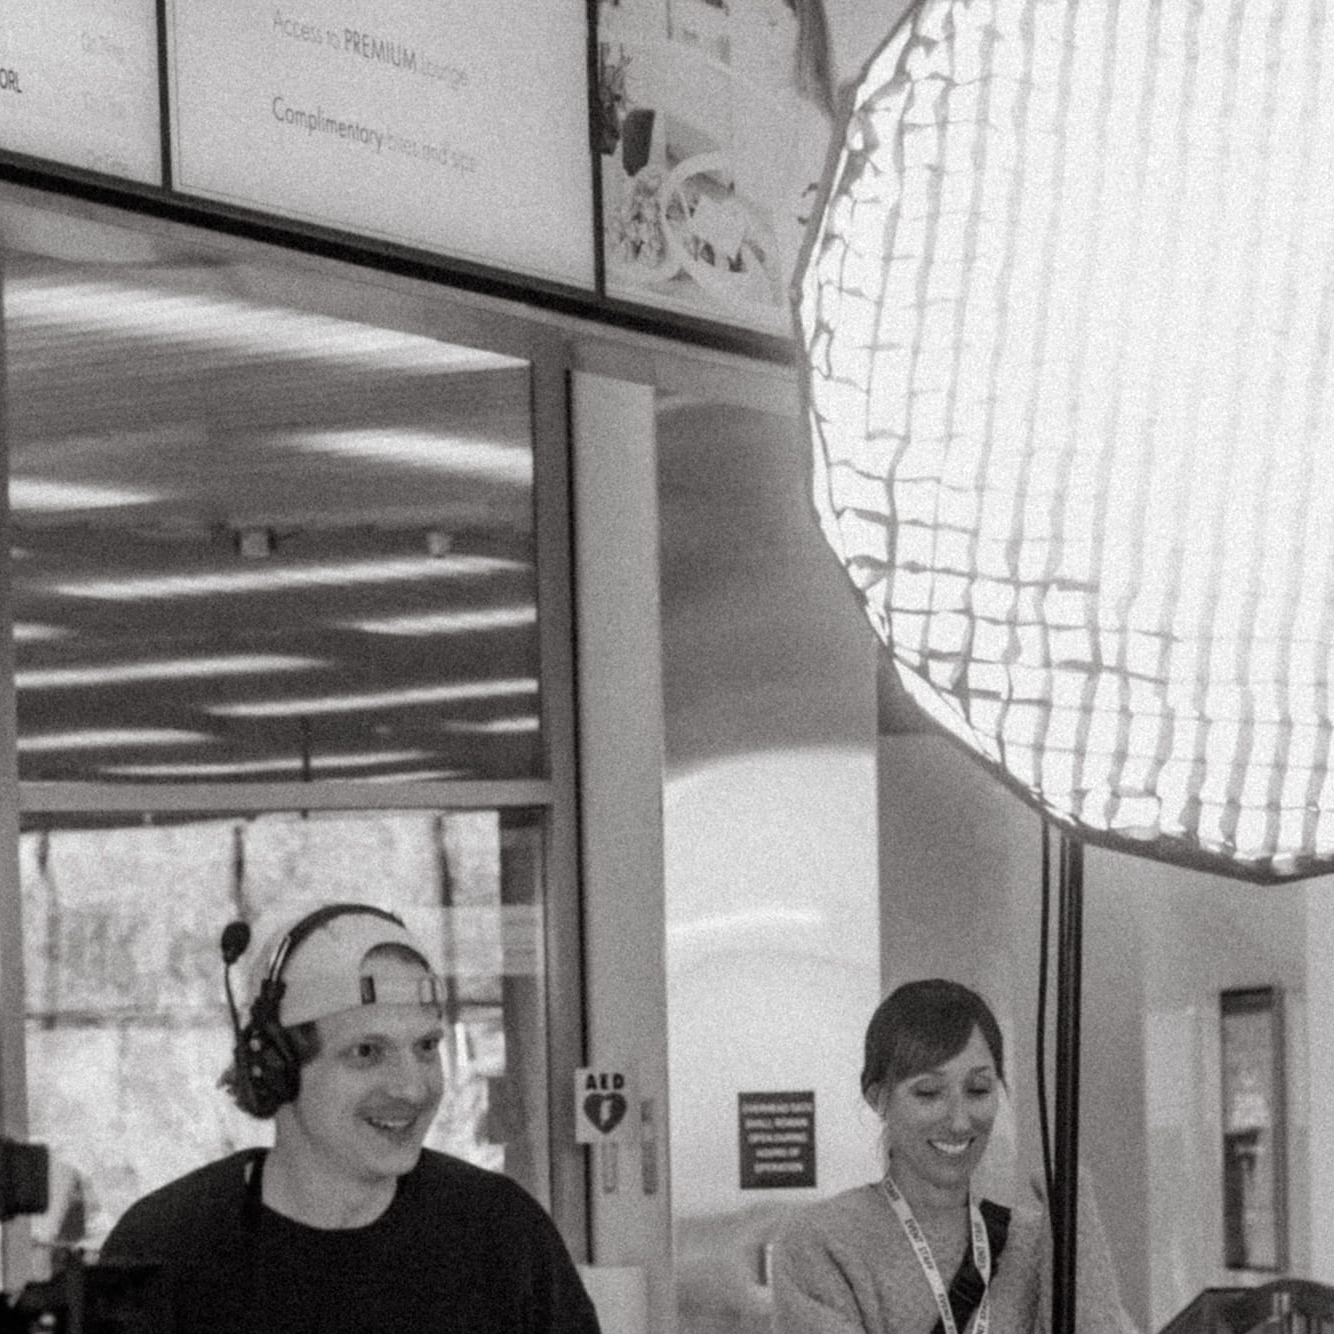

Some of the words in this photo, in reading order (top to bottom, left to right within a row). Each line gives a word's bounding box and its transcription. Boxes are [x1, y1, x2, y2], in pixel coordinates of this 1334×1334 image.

[273, 9, 323, 45] Access
[344, 27, 418, 73] PREMIUM
[271, 95, 383, 154] Complimentary
[585, 1072, 625, 1091] AED
[905, 1217, 924, 1243] EVENT
